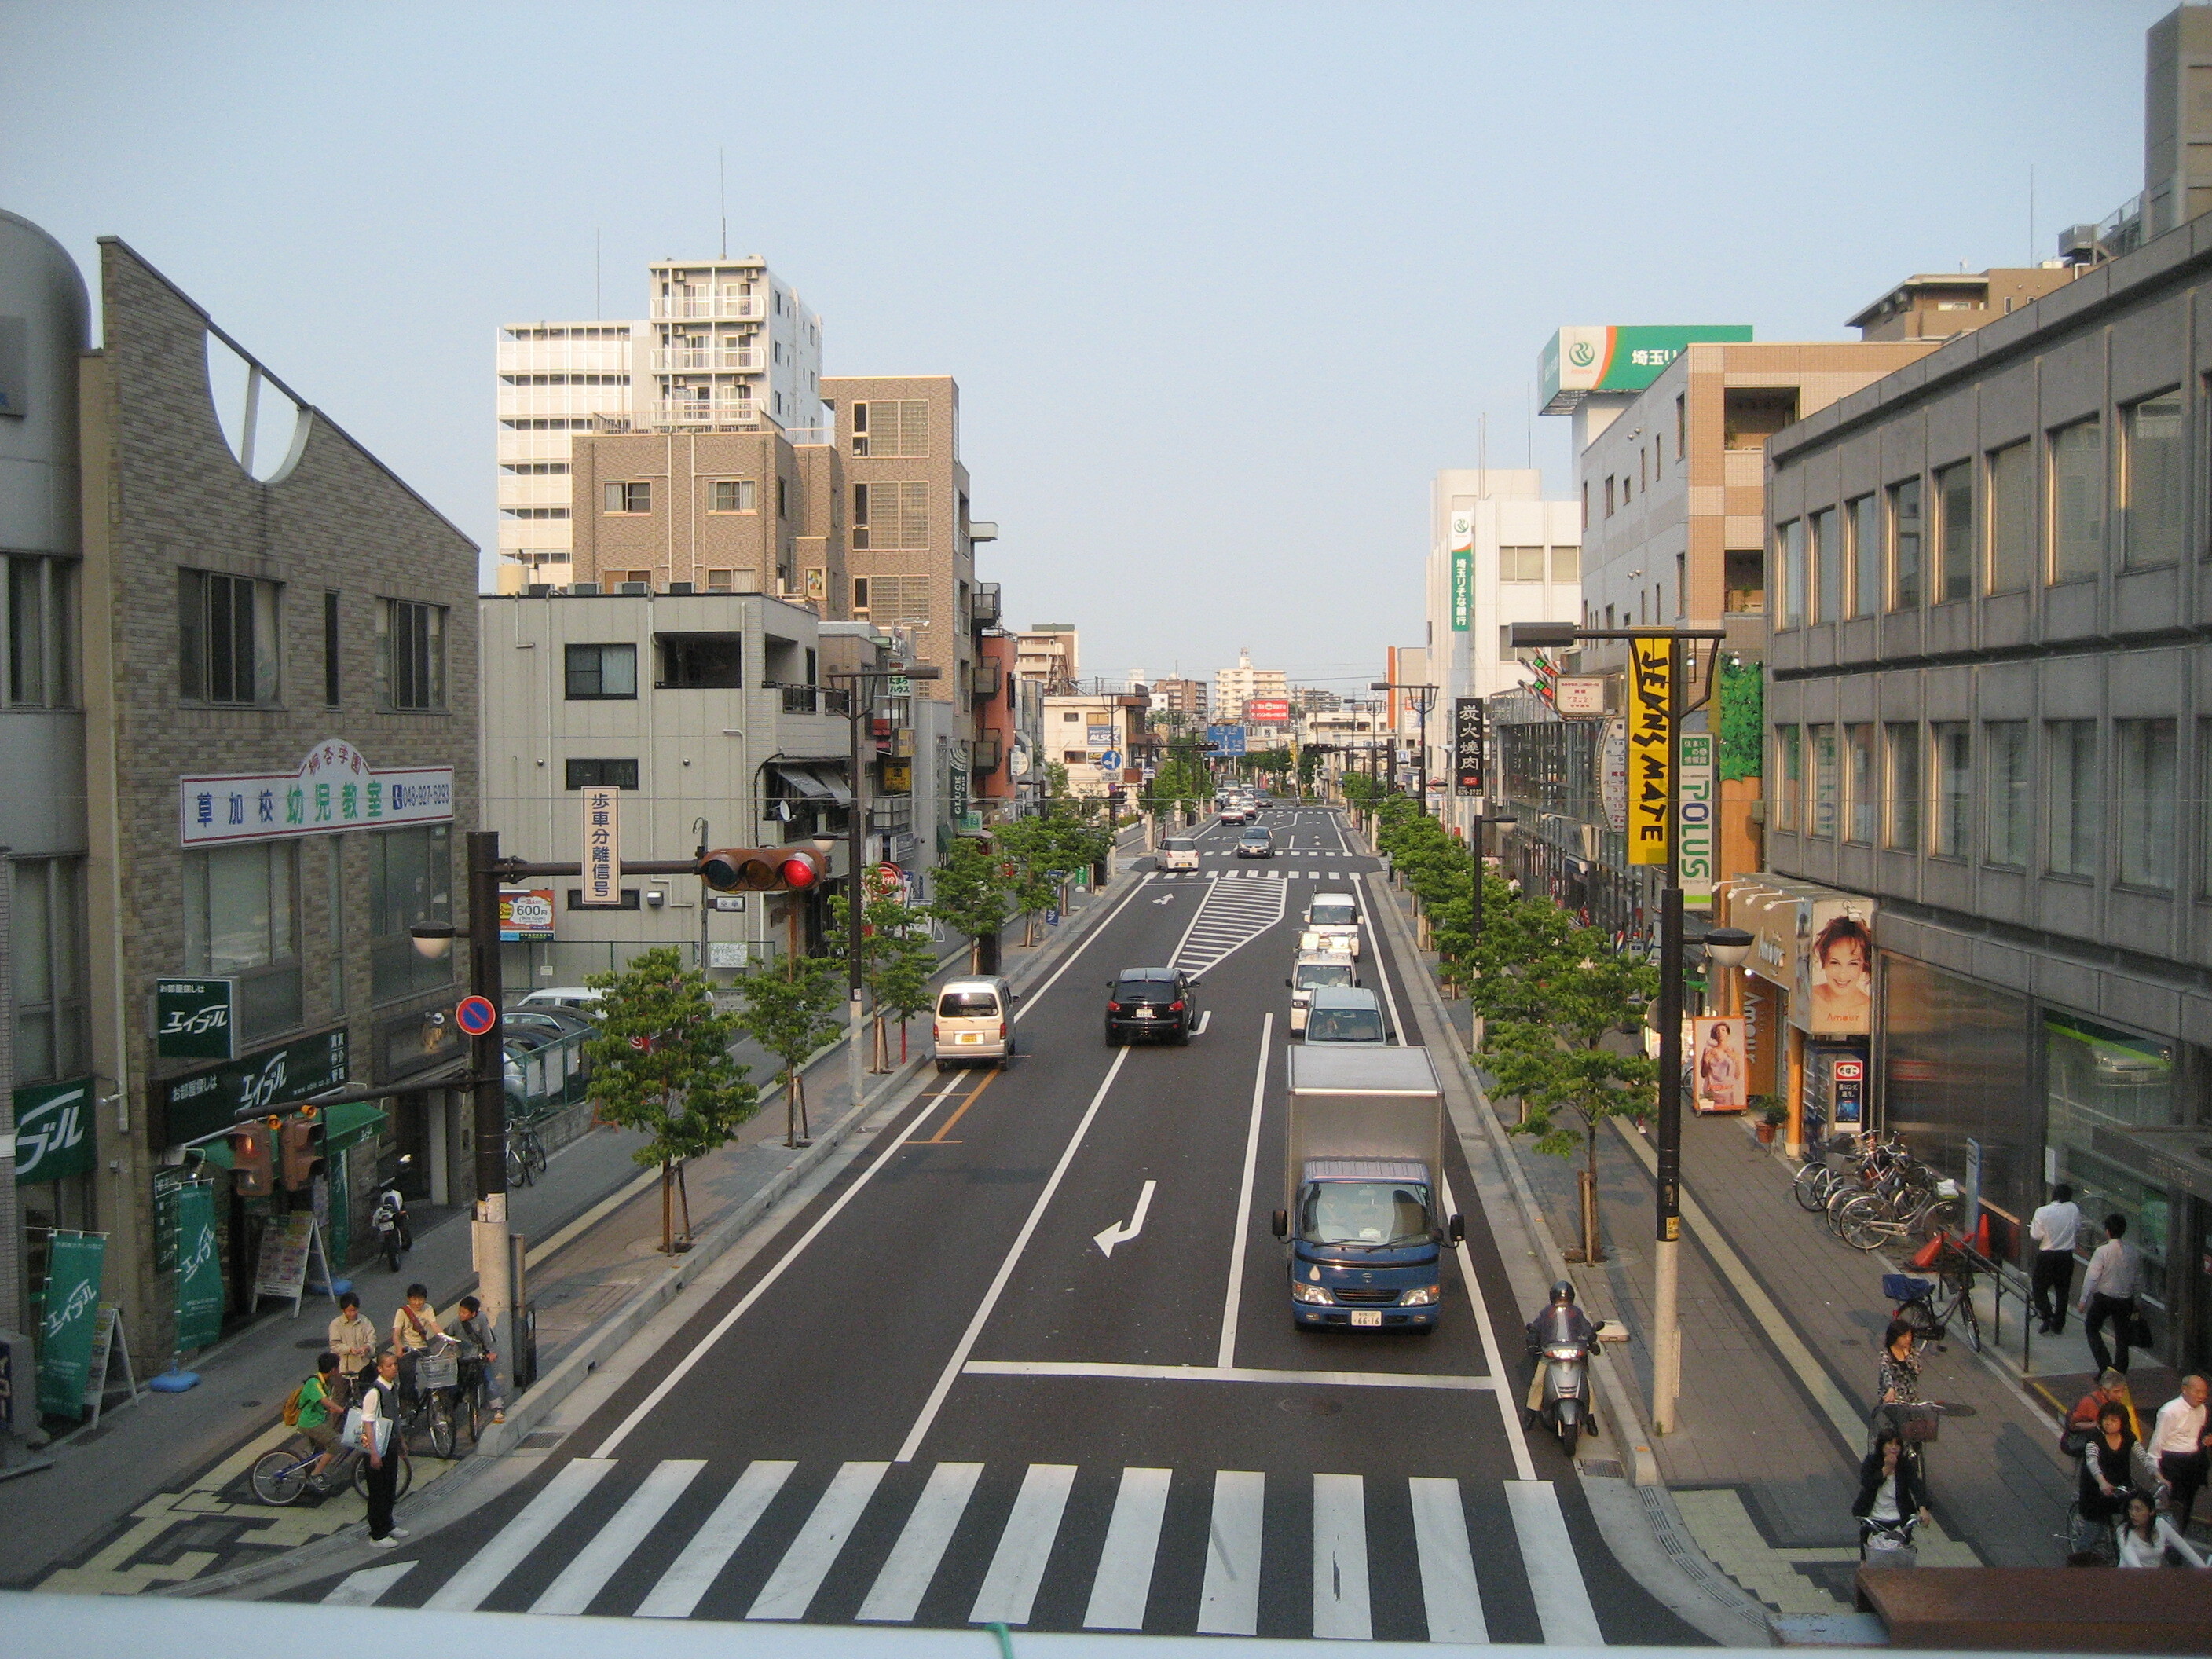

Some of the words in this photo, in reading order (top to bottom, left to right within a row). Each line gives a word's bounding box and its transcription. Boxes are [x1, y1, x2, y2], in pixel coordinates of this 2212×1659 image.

[1456, 558, 1467, 626] 埼玉りそな銀行
[1639, 753, 1668, 841] MATE
[1681, 779, 1709, 878] POLUS
[591, 793, 610, 897] 歩車分離信号
[159, 1004, 229, 1034] エイブル
[1826, 1013, 1861, 1022] Amour
[236, 1050, 287, 1113] エイブル
[181, 1222, 214, 1283] エイブル
[48, 1278, 97, 1338] エイブル
